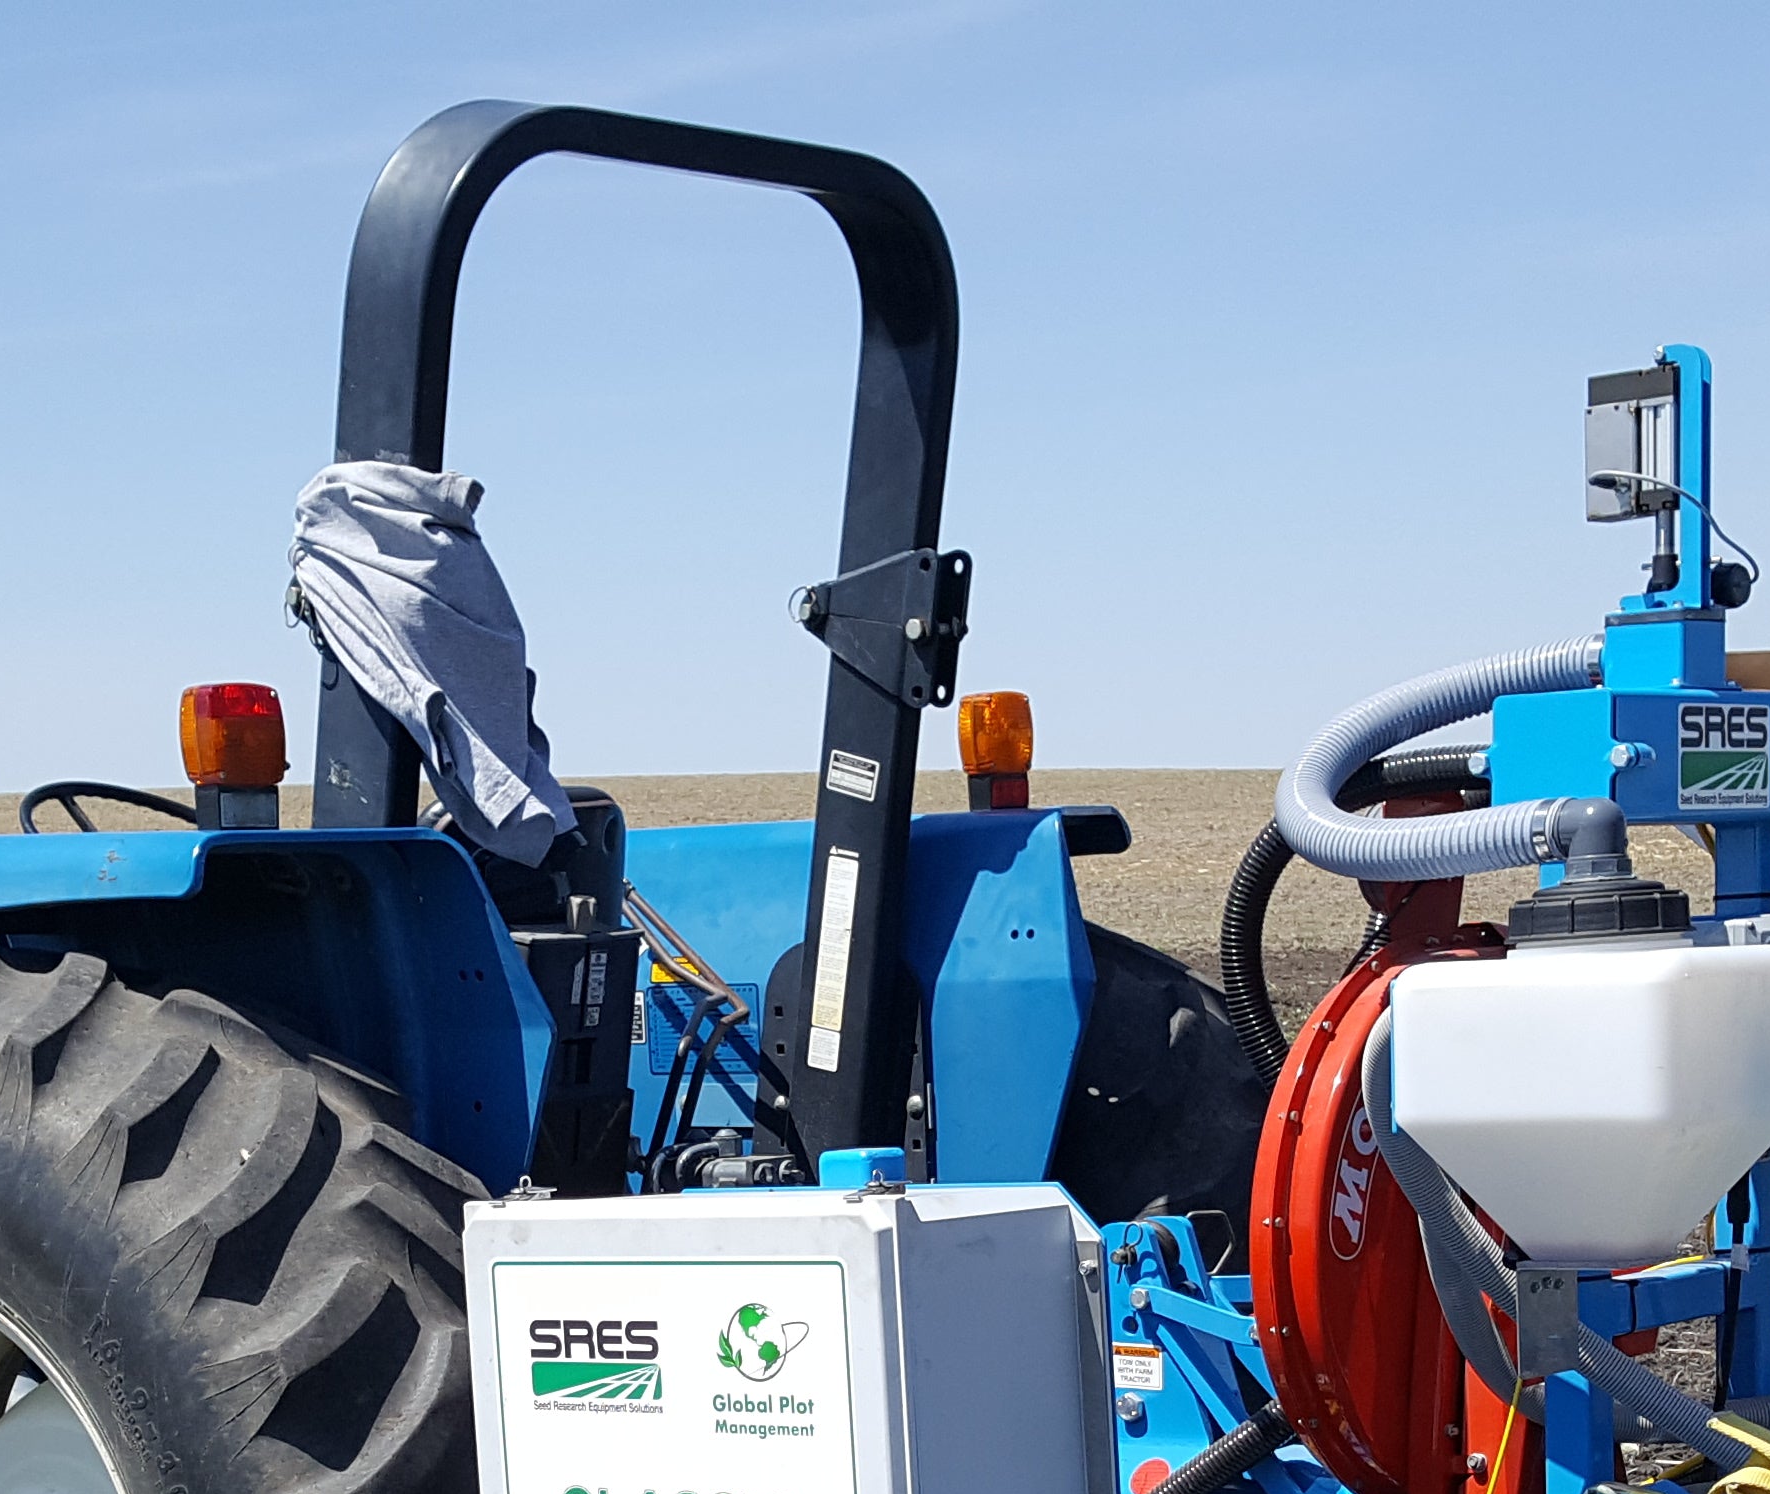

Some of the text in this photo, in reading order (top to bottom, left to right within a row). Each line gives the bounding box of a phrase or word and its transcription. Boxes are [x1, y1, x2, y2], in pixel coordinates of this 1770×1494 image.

[1681, 706, 1768, 748] SRES
[529, 1319, 659, 1360] SRES
[1120, 1375, 1151, 1383] TRACTOR
[533, 1400, 664, 1414] Seed Research Equipment Solutions
[712, 1393, 814, 1414] Global Plot
[715, 1419, 814, 1439] Management
